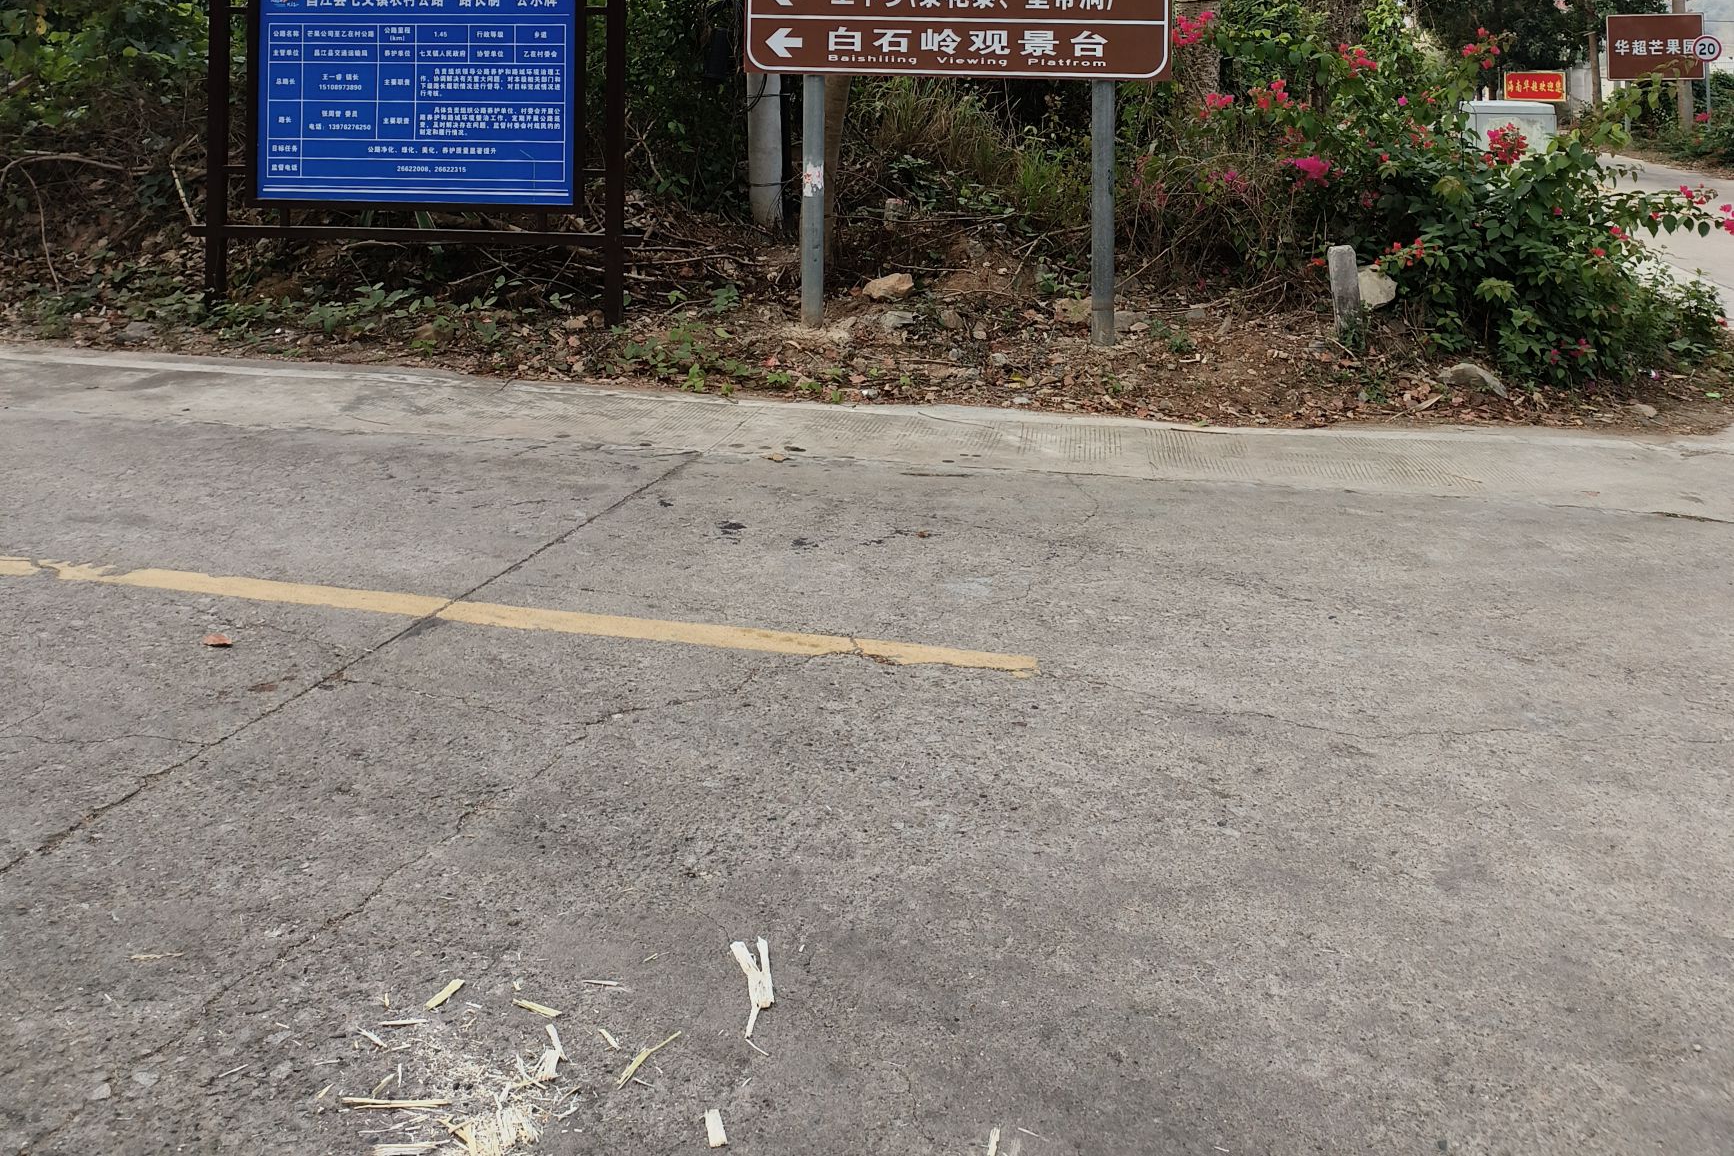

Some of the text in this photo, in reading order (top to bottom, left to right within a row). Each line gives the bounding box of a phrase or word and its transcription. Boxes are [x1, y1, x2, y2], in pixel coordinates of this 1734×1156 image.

[829, 27, 1108, 58] 白石岭观景台
[1699, 43, 1715, 55] 20
[829, 55, 1106, 66] Baishiling Viewing Platfrom
